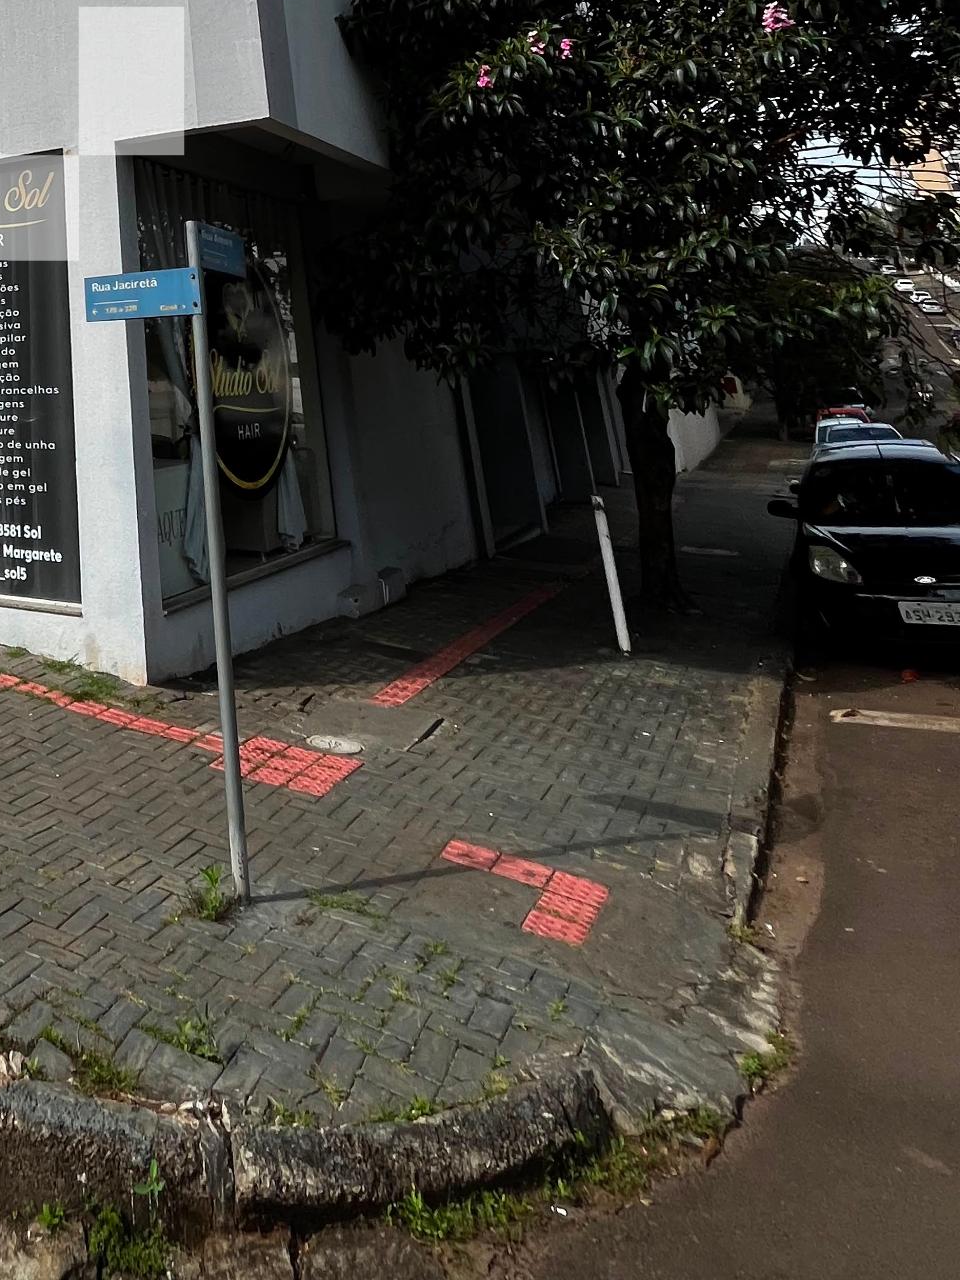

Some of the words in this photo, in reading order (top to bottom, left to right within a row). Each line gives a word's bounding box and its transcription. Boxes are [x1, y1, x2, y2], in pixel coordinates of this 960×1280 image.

[4, 170, 54, 212] Sol
[91, 282, 111, 292] Rua
[237, 423, 261, 440] HAIR
[7, 440, 22, 449] de
[25, 440, 56, 450] unha
[12, 468, 31, 478] gel
[7, 483, 25, 491] em
[28, 483, 47, 493] gel
[5, 496, 27, 506] pés
[23, 526, 42, 539] Sol
[3, 544, 62, 563] Margarete
